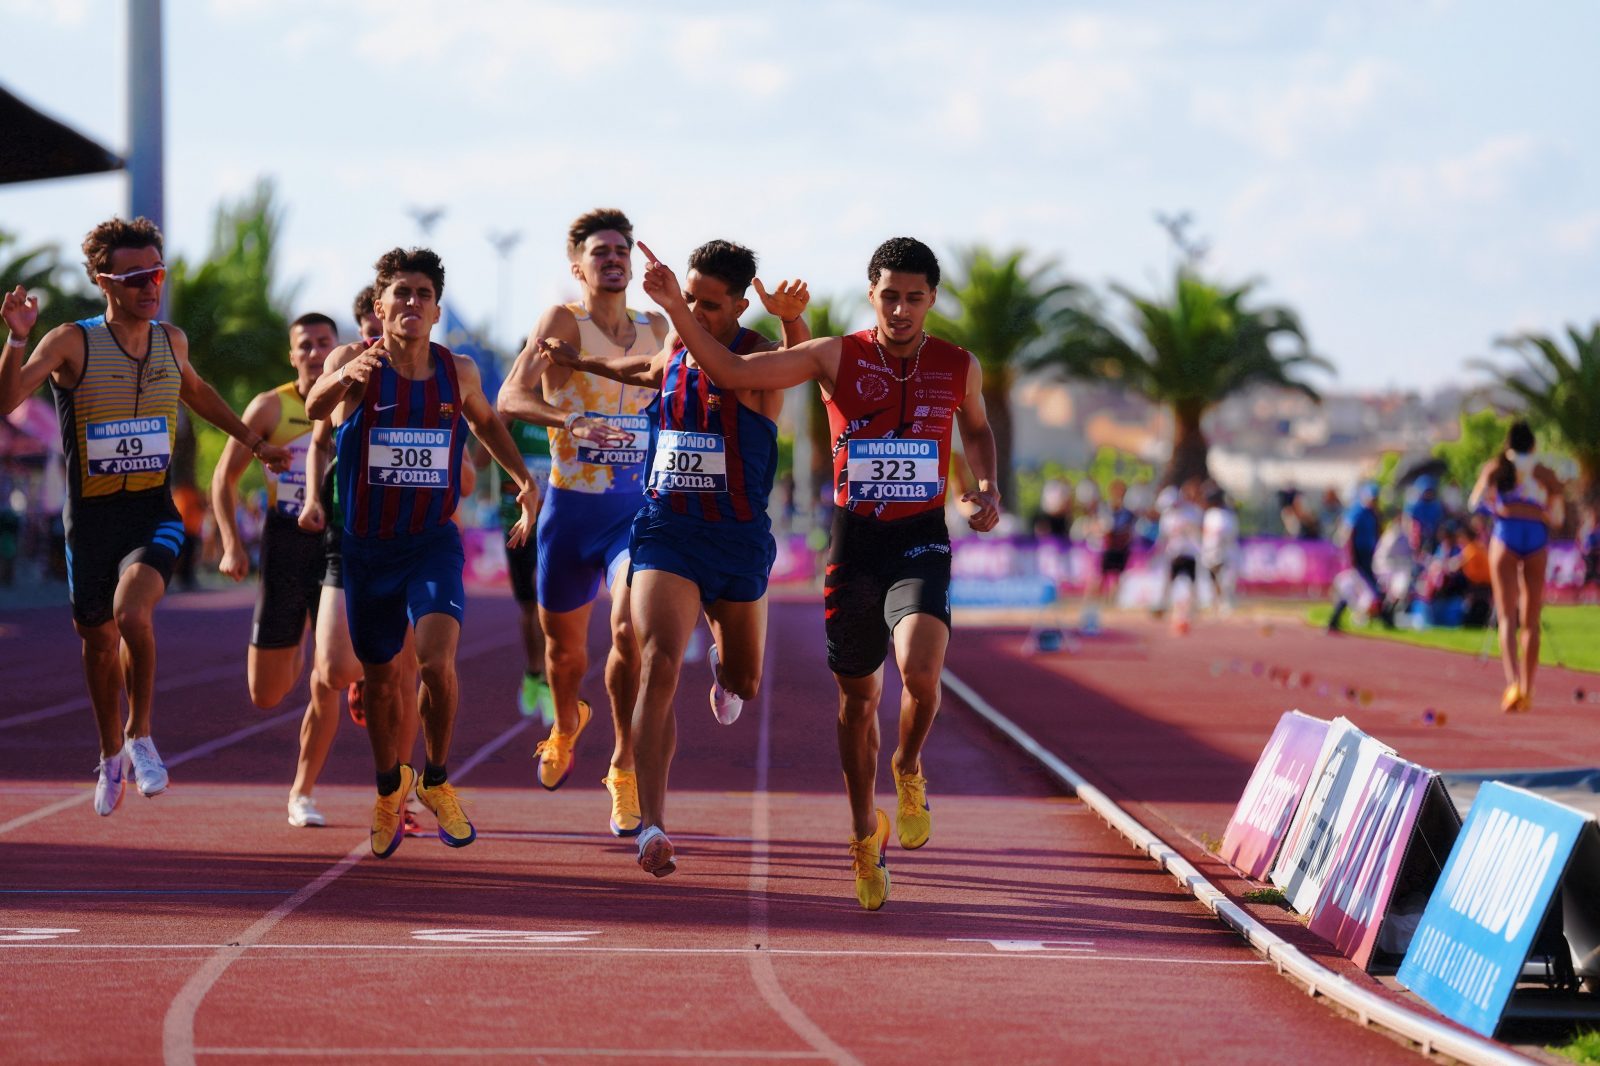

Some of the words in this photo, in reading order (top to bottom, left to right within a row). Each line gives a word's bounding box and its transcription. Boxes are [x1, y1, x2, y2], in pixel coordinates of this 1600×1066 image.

[105, 419, 160, 436] MONDO
[116, 437, 143, 456] 49
[390, 432, 445, 444] MONDO
[665, 435, 716, 449] MONDO
[391, 448, 432, 468] 308
[868, 443, 930, 456] MONDO
[666, 452, 704, 473] 302
[871, 460, 916, 481] 323
[1450, 807, 1559, 943] MONDO
